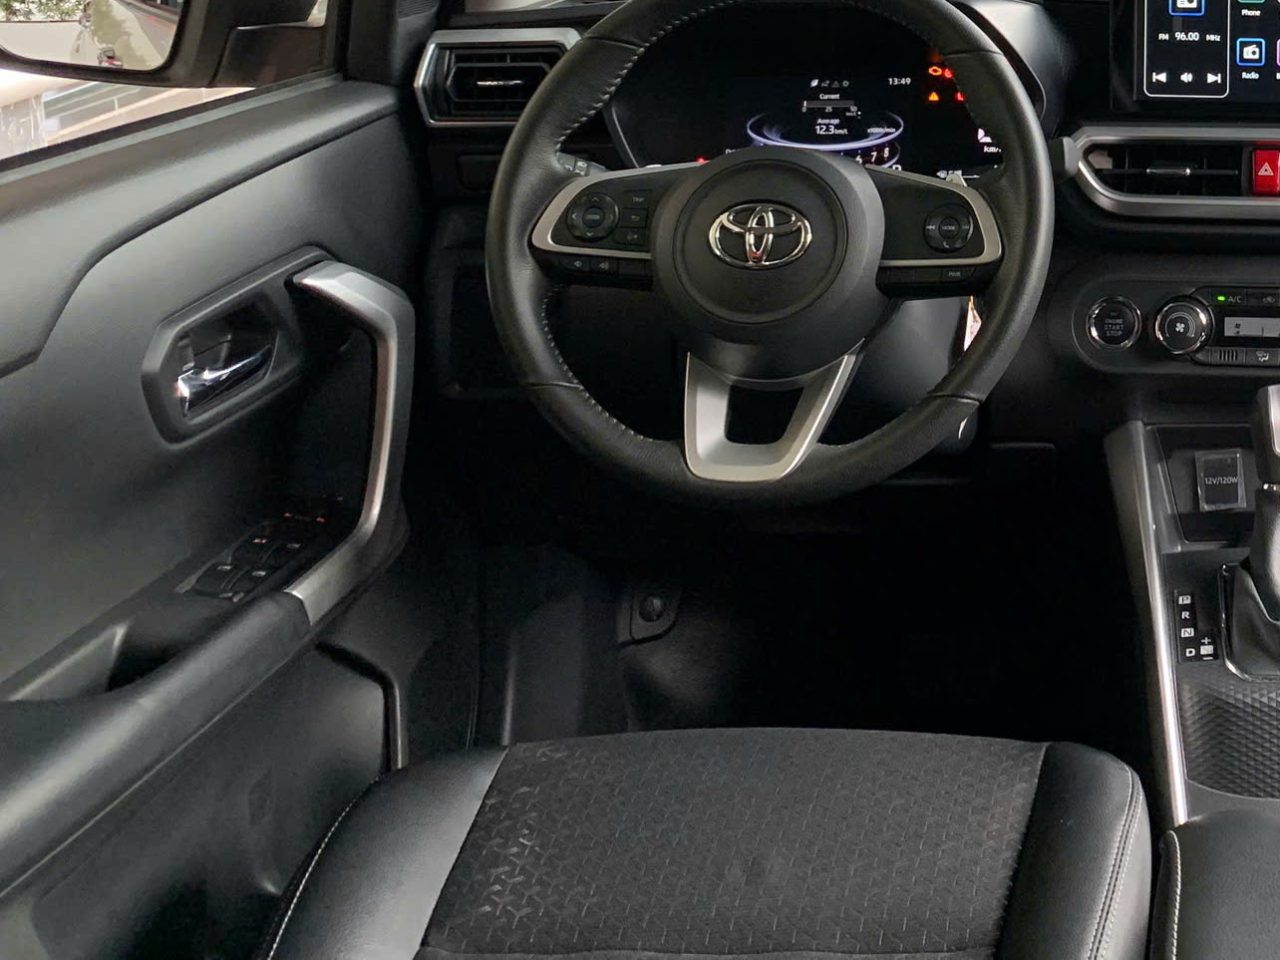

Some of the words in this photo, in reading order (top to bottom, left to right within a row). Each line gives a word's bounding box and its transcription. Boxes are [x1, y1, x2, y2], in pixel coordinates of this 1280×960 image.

[1241, 9, 1261, 17] Phone
[1158, 33, 1169, 41] FM
[1174, 31, 1200, 41] 96.00
[1205, 34, 1221, 42] MHz
[1241, 72, 1260, 80] Radio
[888, 77, 911, 86] 13:49
[815, 125, 835, 135] 12.3
[1228, 295, 1242, 304] A/C
[1205, 476, 1239, 485] 12V/120W
[1181, 611, 1190, 619] R
[1186, 648, 1195, 657] D
